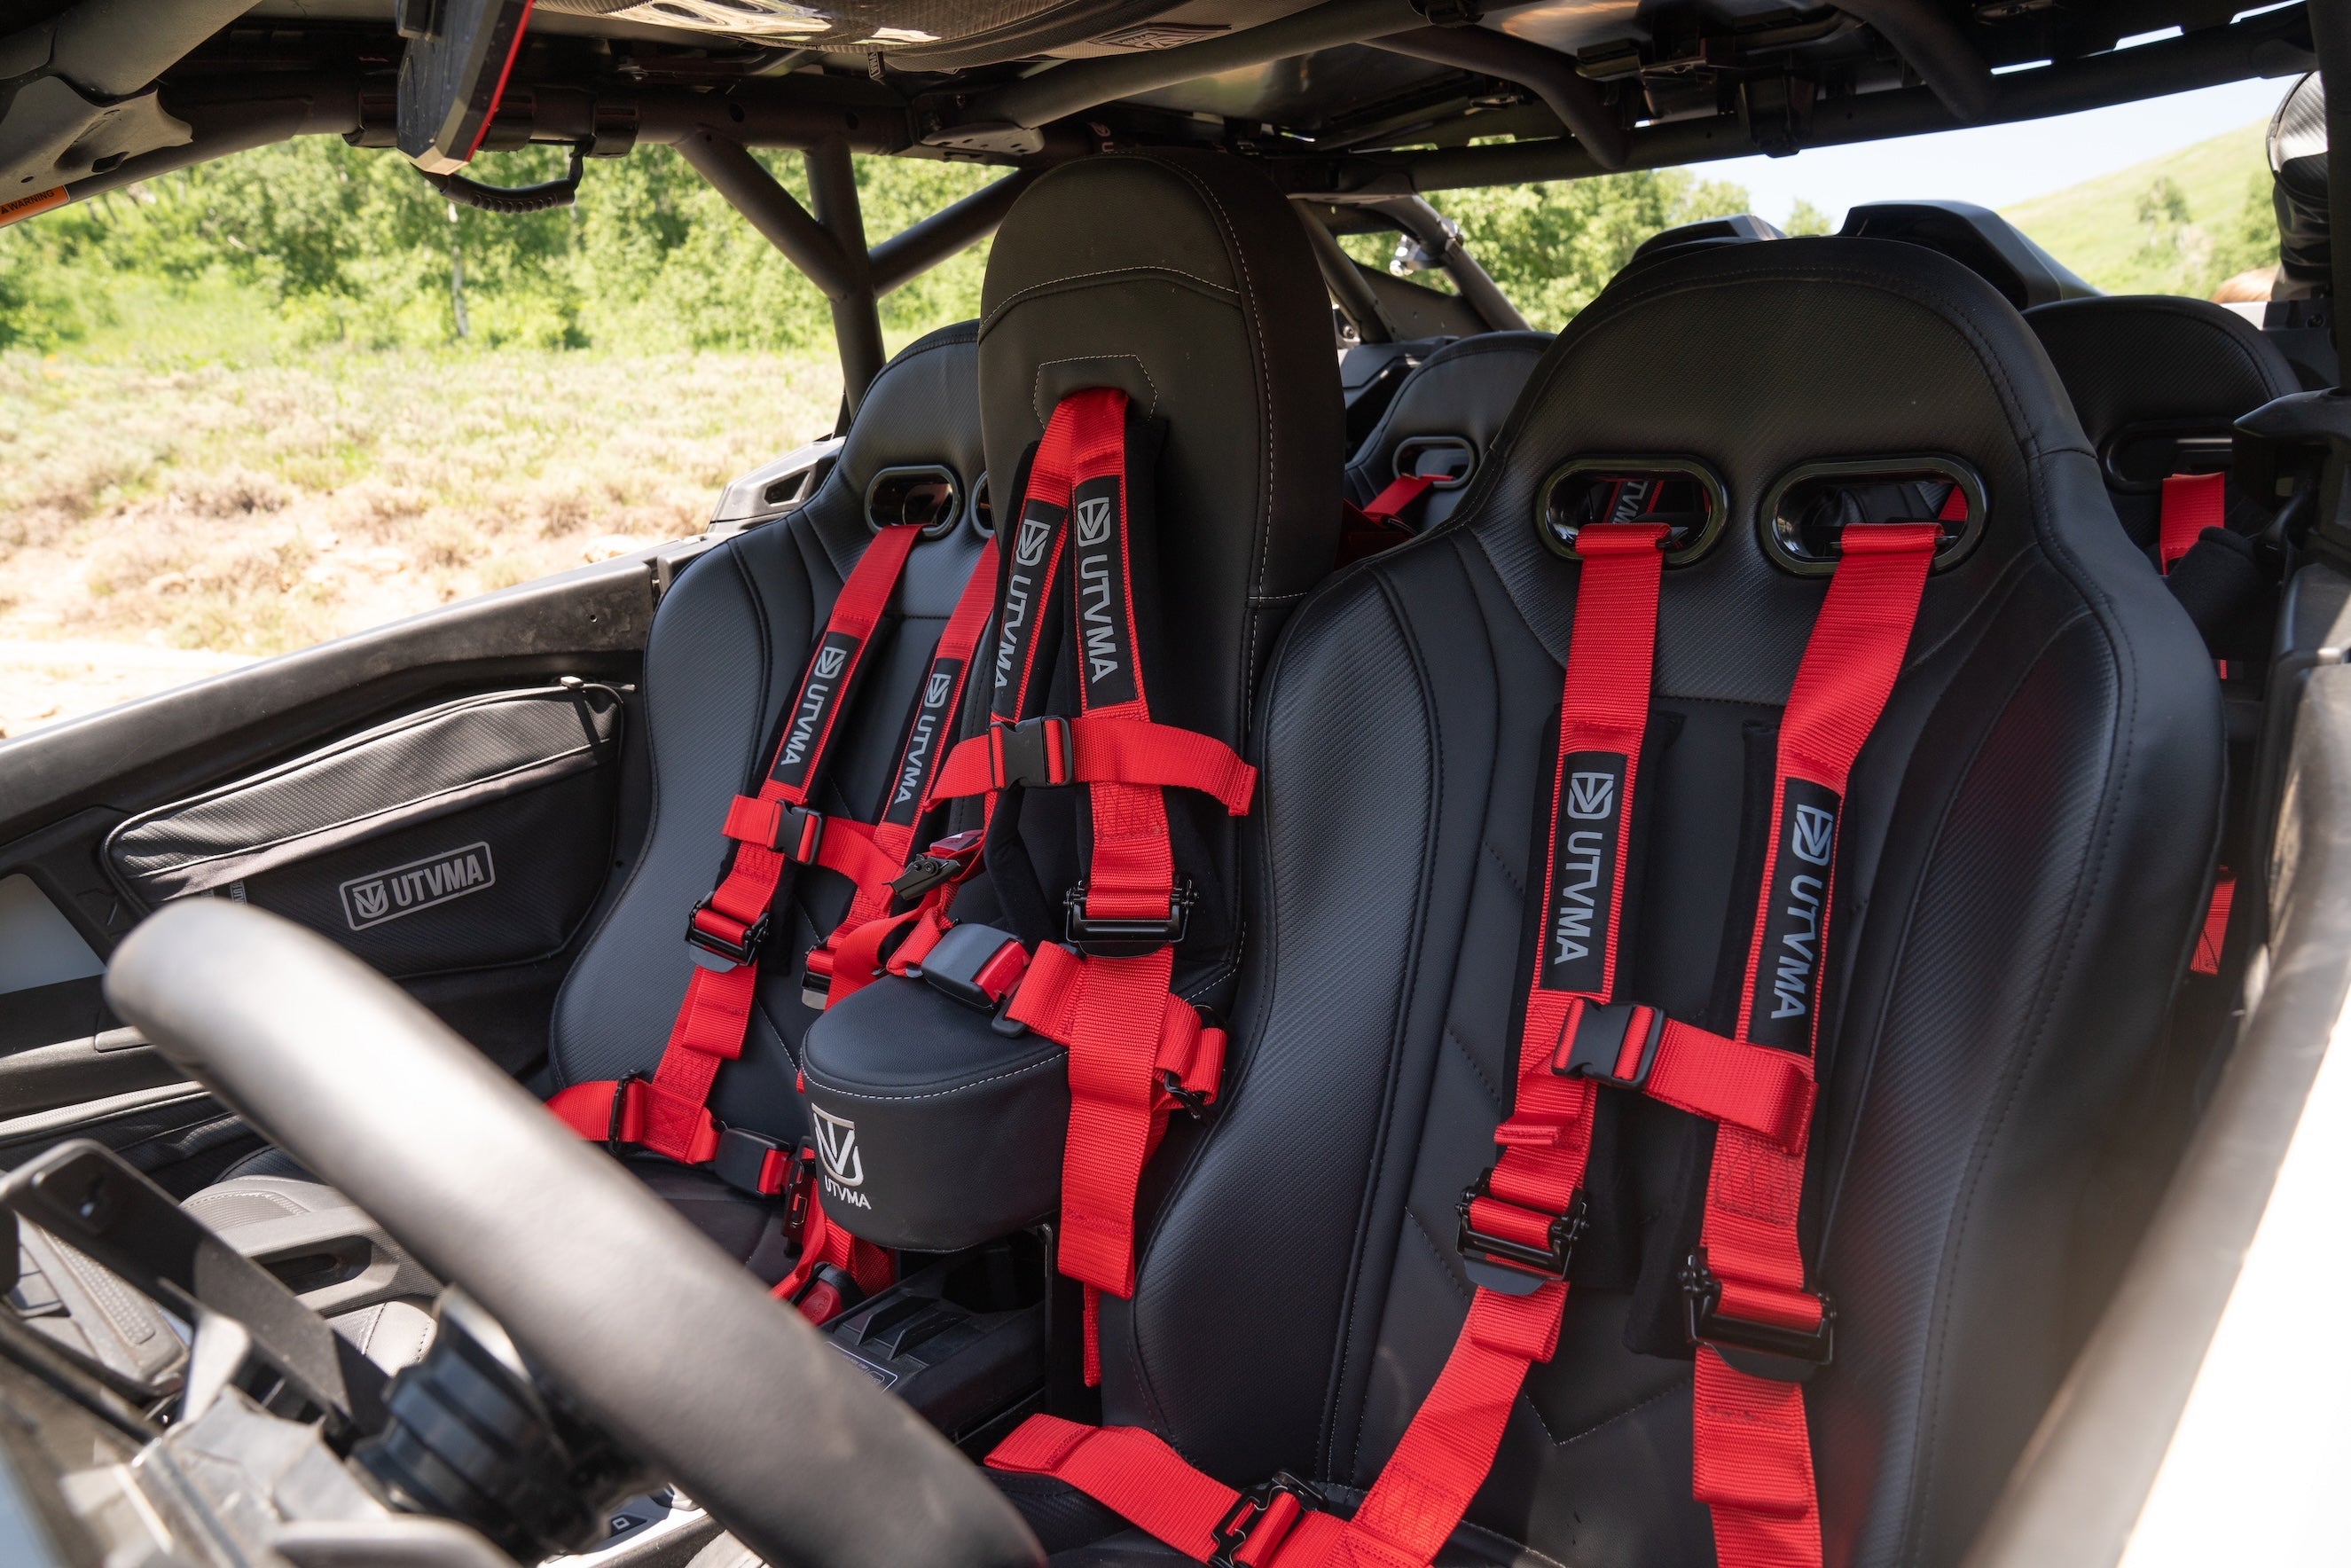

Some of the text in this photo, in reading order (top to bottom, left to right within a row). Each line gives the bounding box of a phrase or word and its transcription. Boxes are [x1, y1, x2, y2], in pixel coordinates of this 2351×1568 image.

[8, 189, 55, 211] WARNING
[994, 574, 1032, 688] UTVMA
[1080, 553, 1118, 684] UTVMA
[780, 684, 829, 765] UTVMA
[894, 715, 936, 804] UTVMA
[391, 854, 485, 906] UTVMA
[1554, 831, 1603, 965] UTVMA
[1770, 874, 1823, 1019] UTVMA
[824, 1174, 872, 1210] UTVMA
